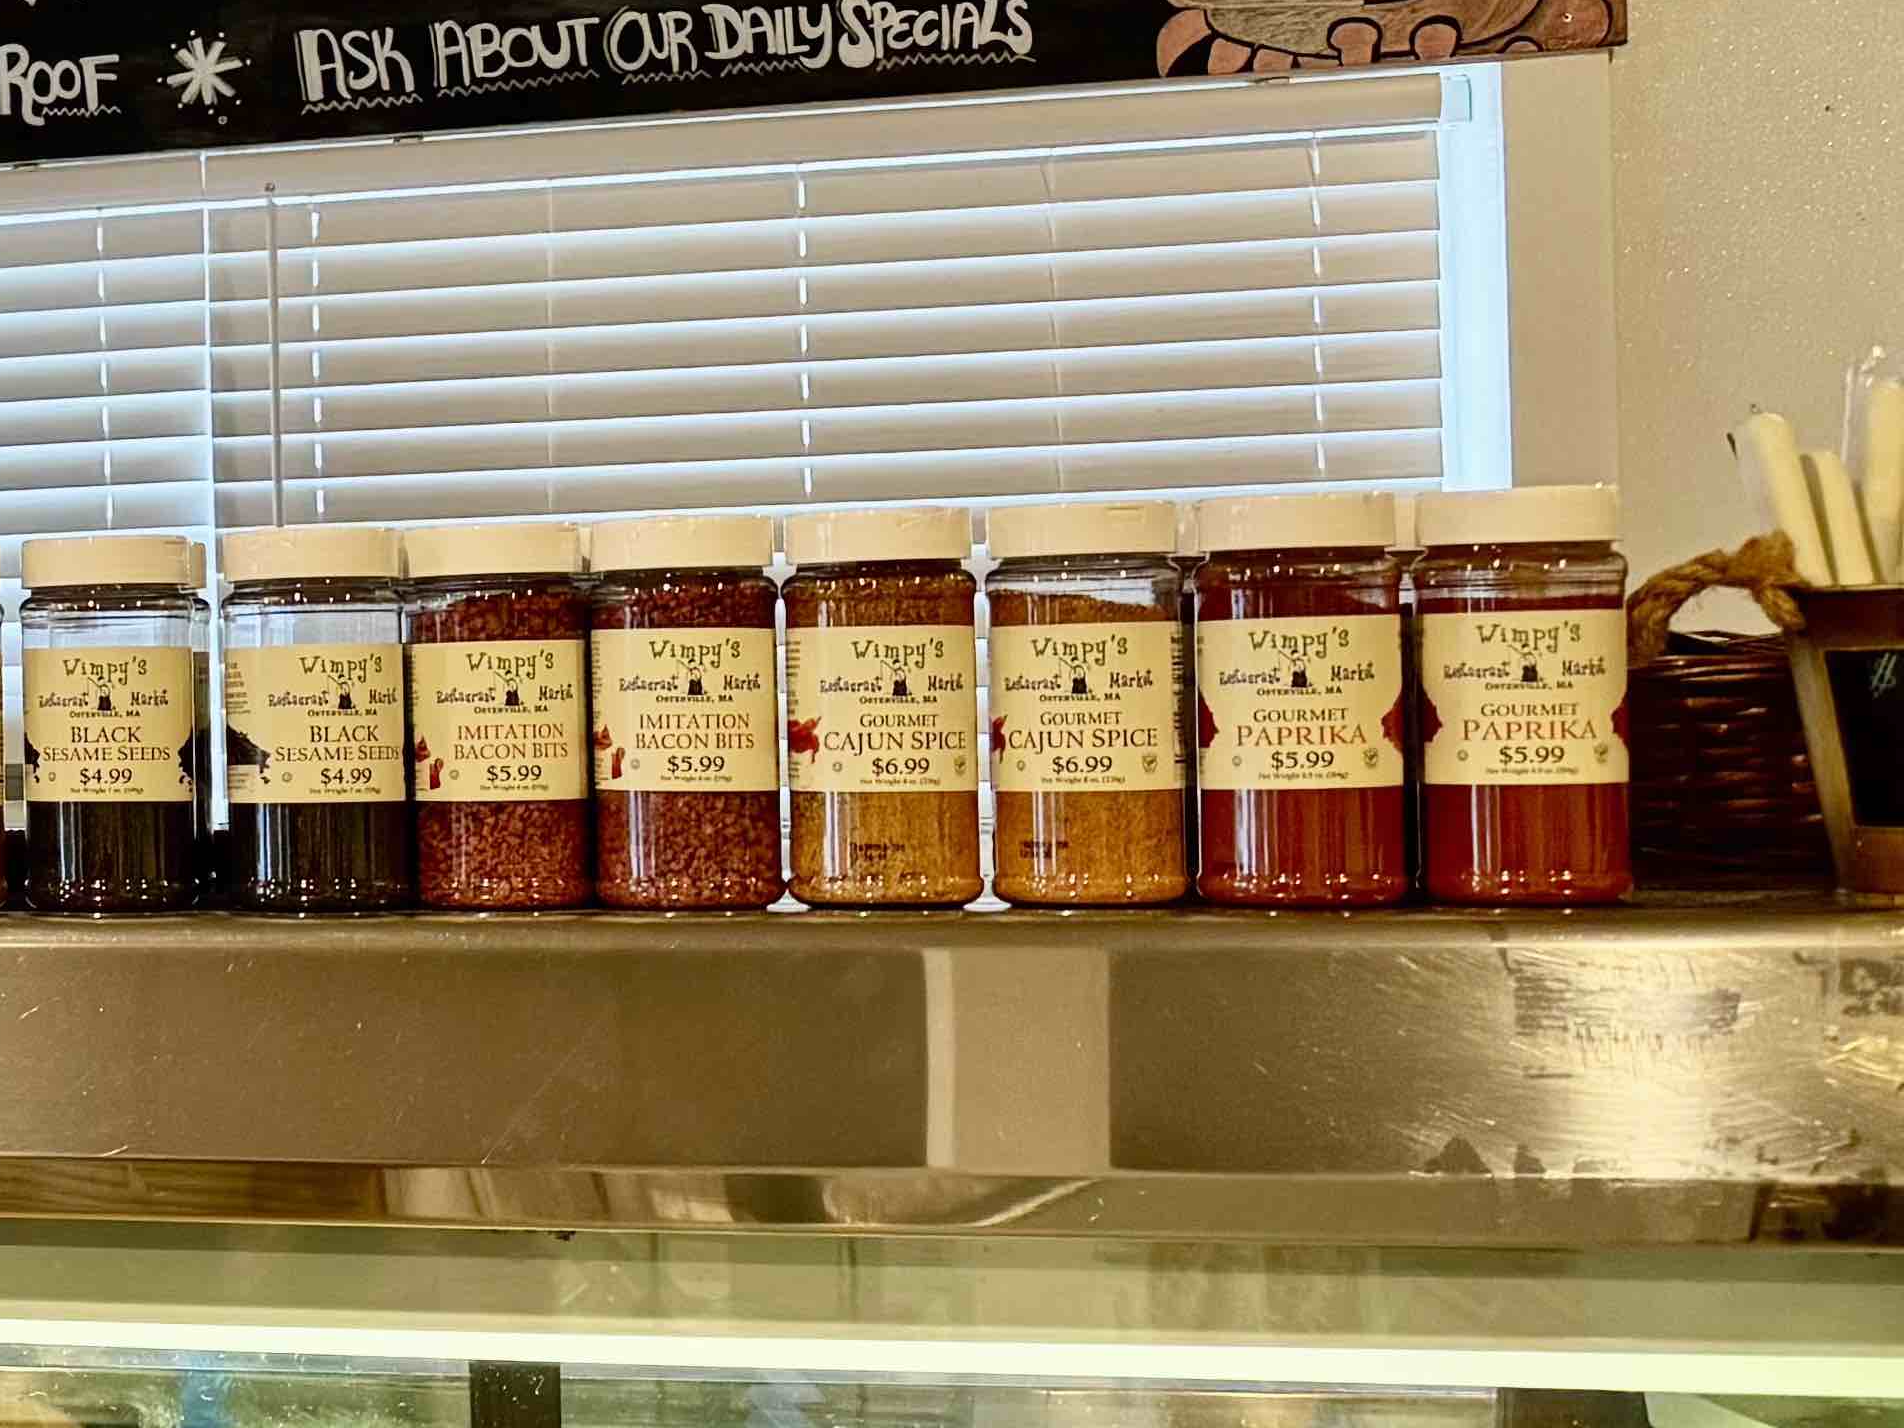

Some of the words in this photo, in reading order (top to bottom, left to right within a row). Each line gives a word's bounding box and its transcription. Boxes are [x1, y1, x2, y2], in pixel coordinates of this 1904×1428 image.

[294, 27, 417, 103] ASK
[433, 13, 599, 89] ABOUT
[702, 0, 833, 70] DAILY
[1040, 711, 1122, 725] GOURMET
[1253, 708, 1349, 723] GOURMET
[1480, 702, 1579, 718] GOURMET
[640, 713, 750, 730] IMITATION
[860, 714, 939, 728] GOURMET
[1463, 718, 1597, 741] PAPRIKA
[310, 725, 379, 742] BLACK
[458, 723, 564, 740] IMITATION
[1237, 725, 1367, 747] PAPRIKA
[635, 734, 710, 749] BACON
[716, 733, 755, 749] BITS
[824, 732, 903, 756] CAJUN
[911, 732, 967, 750] SPICE
[1008, 730, 1085, 754] CAJUN
[1092, 728, 1158, 748] SPICE
[275, 746, 354, 761] SESAME
[454, 743, 527, 760] BACON
[531, 743, 568, 758] BITS
[1499, 745, 1565, 764] $5.99
[668, 756, 725, 773] $5.99
[872, 758, 931, 775] $6.99
[1052, 756, 1112, 773] $6.99
[1271, 750, 1334, 771] $5.99
[320, 768, 372, 785] $4.99
[487, 765, 542, 784] $5.99
